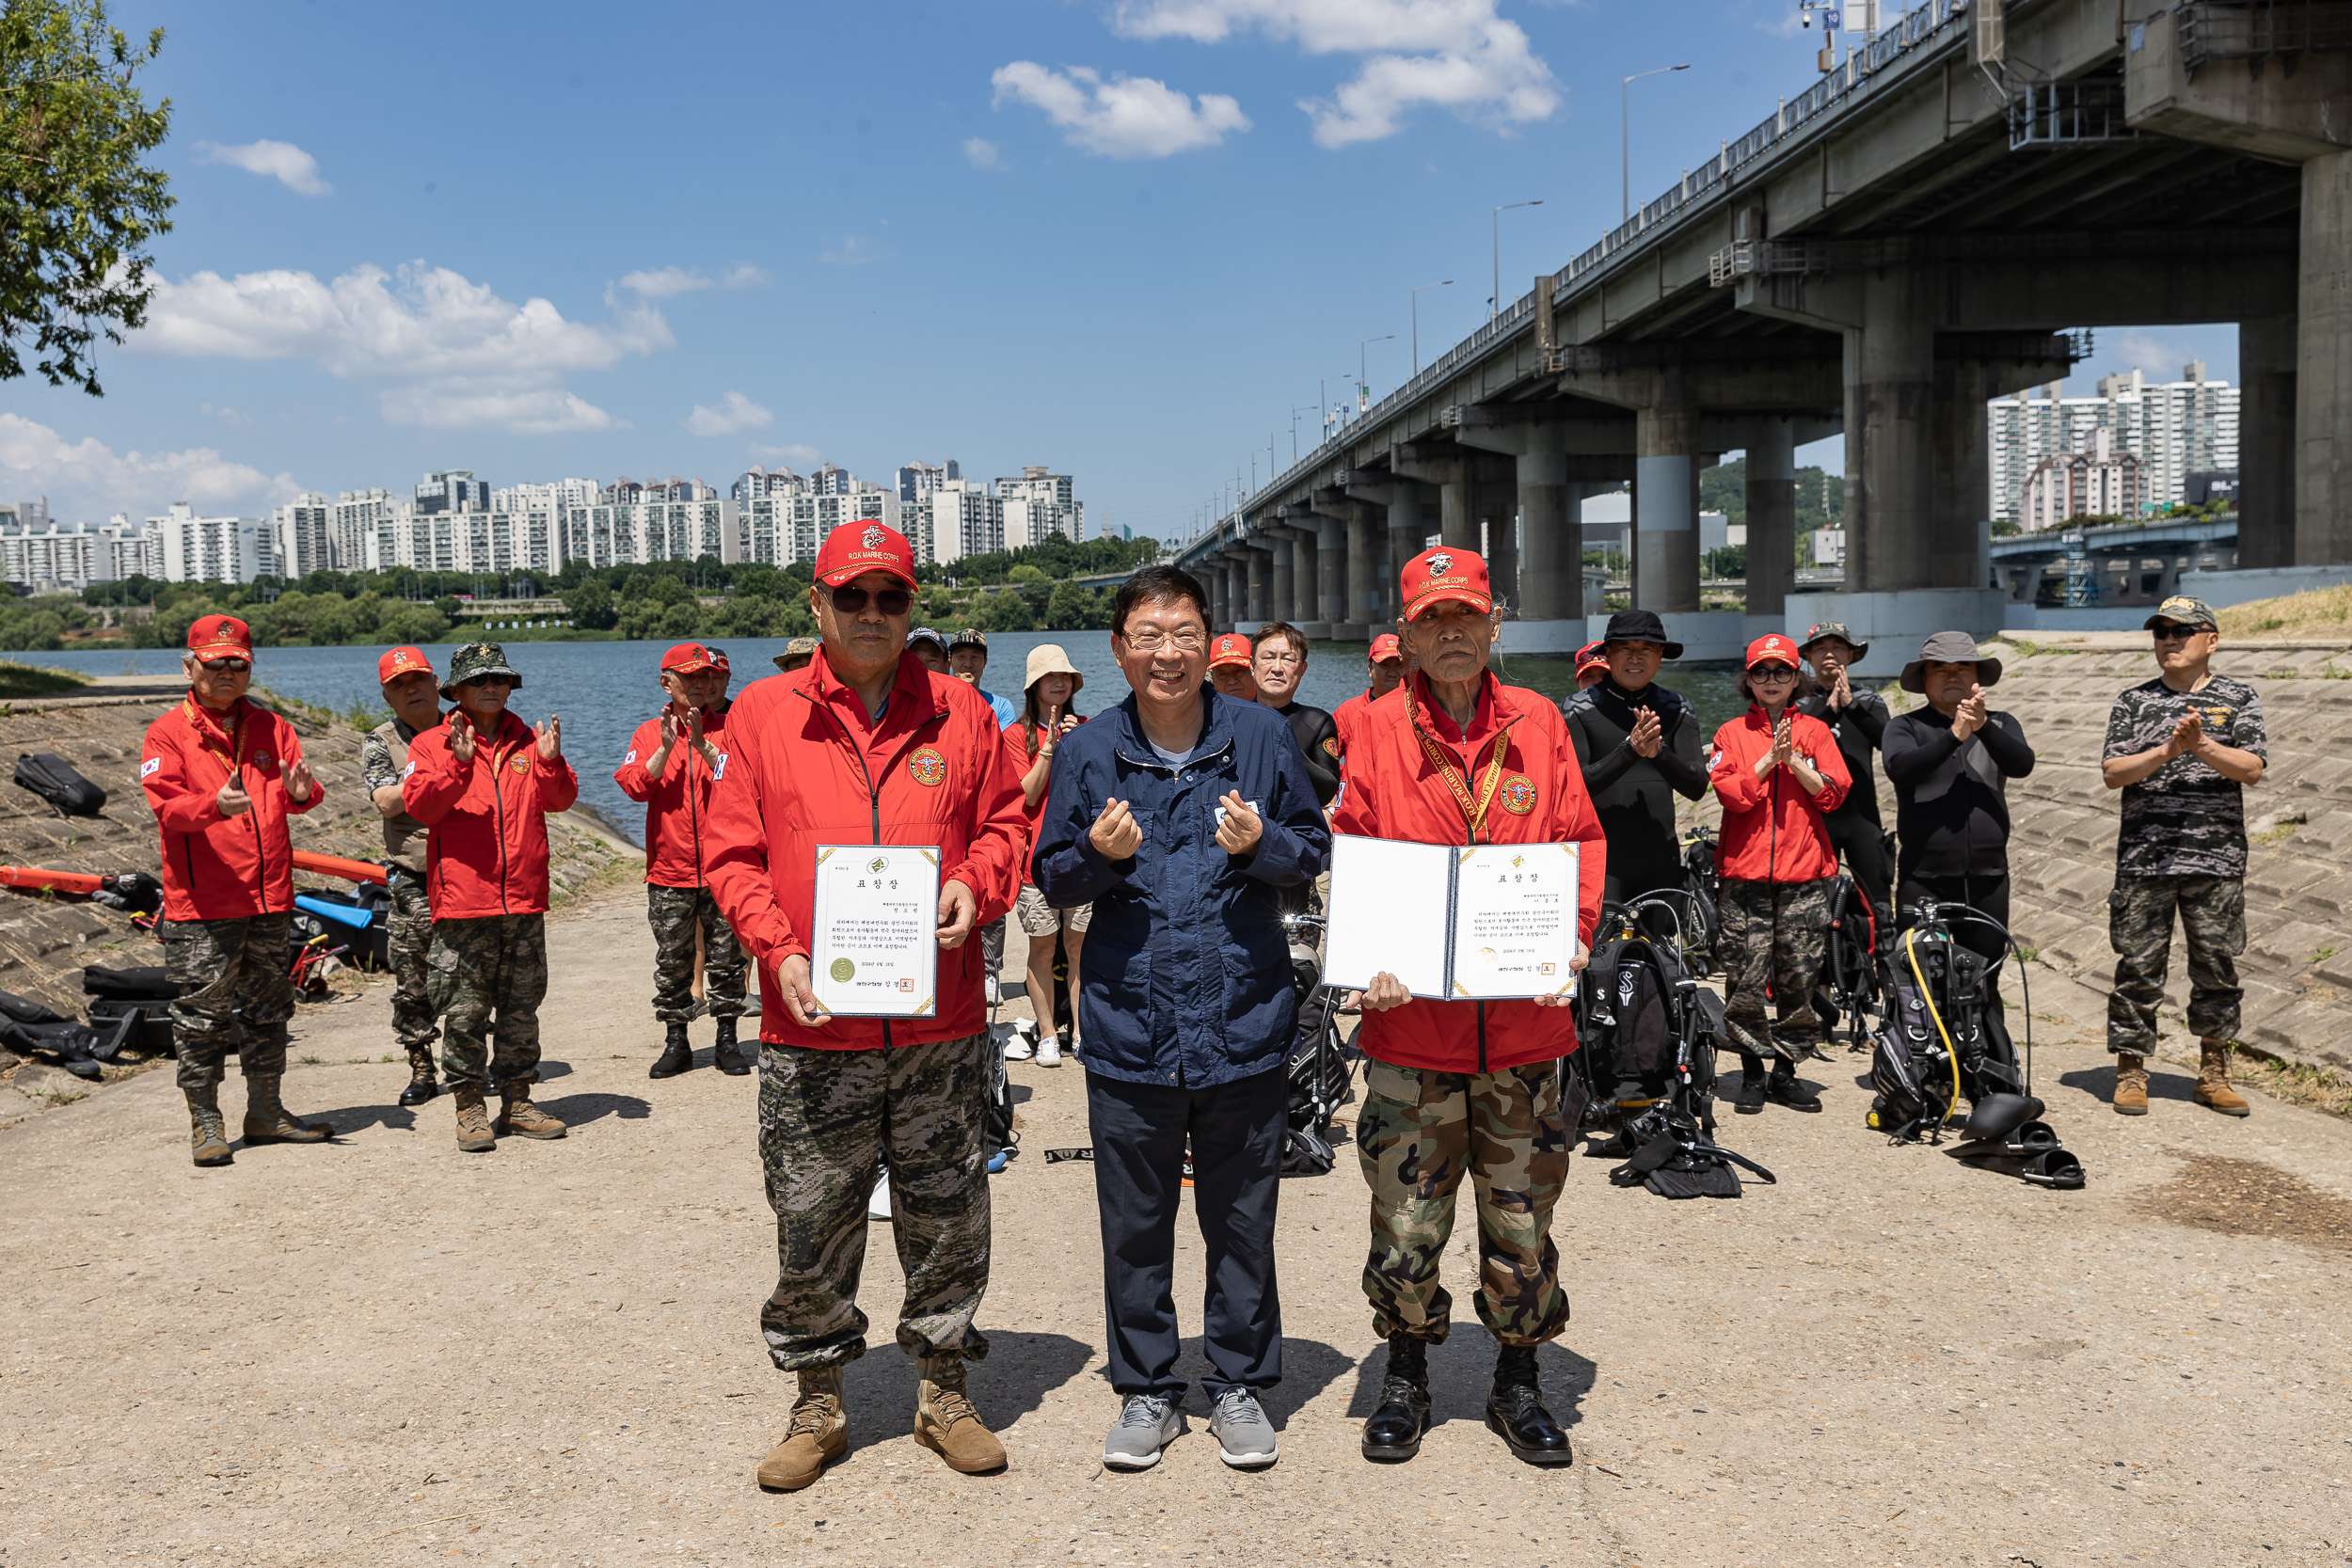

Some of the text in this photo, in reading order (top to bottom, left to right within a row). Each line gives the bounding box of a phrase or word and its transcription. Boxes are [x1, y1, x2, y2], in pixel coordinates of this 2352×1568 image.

[862, 551, 883, 560] MARINE
[883, 552, 899, 563] CORPS
[1430, 578, 1450, 586] MARINE
[1424, 738, 1444, 765] CORPS
